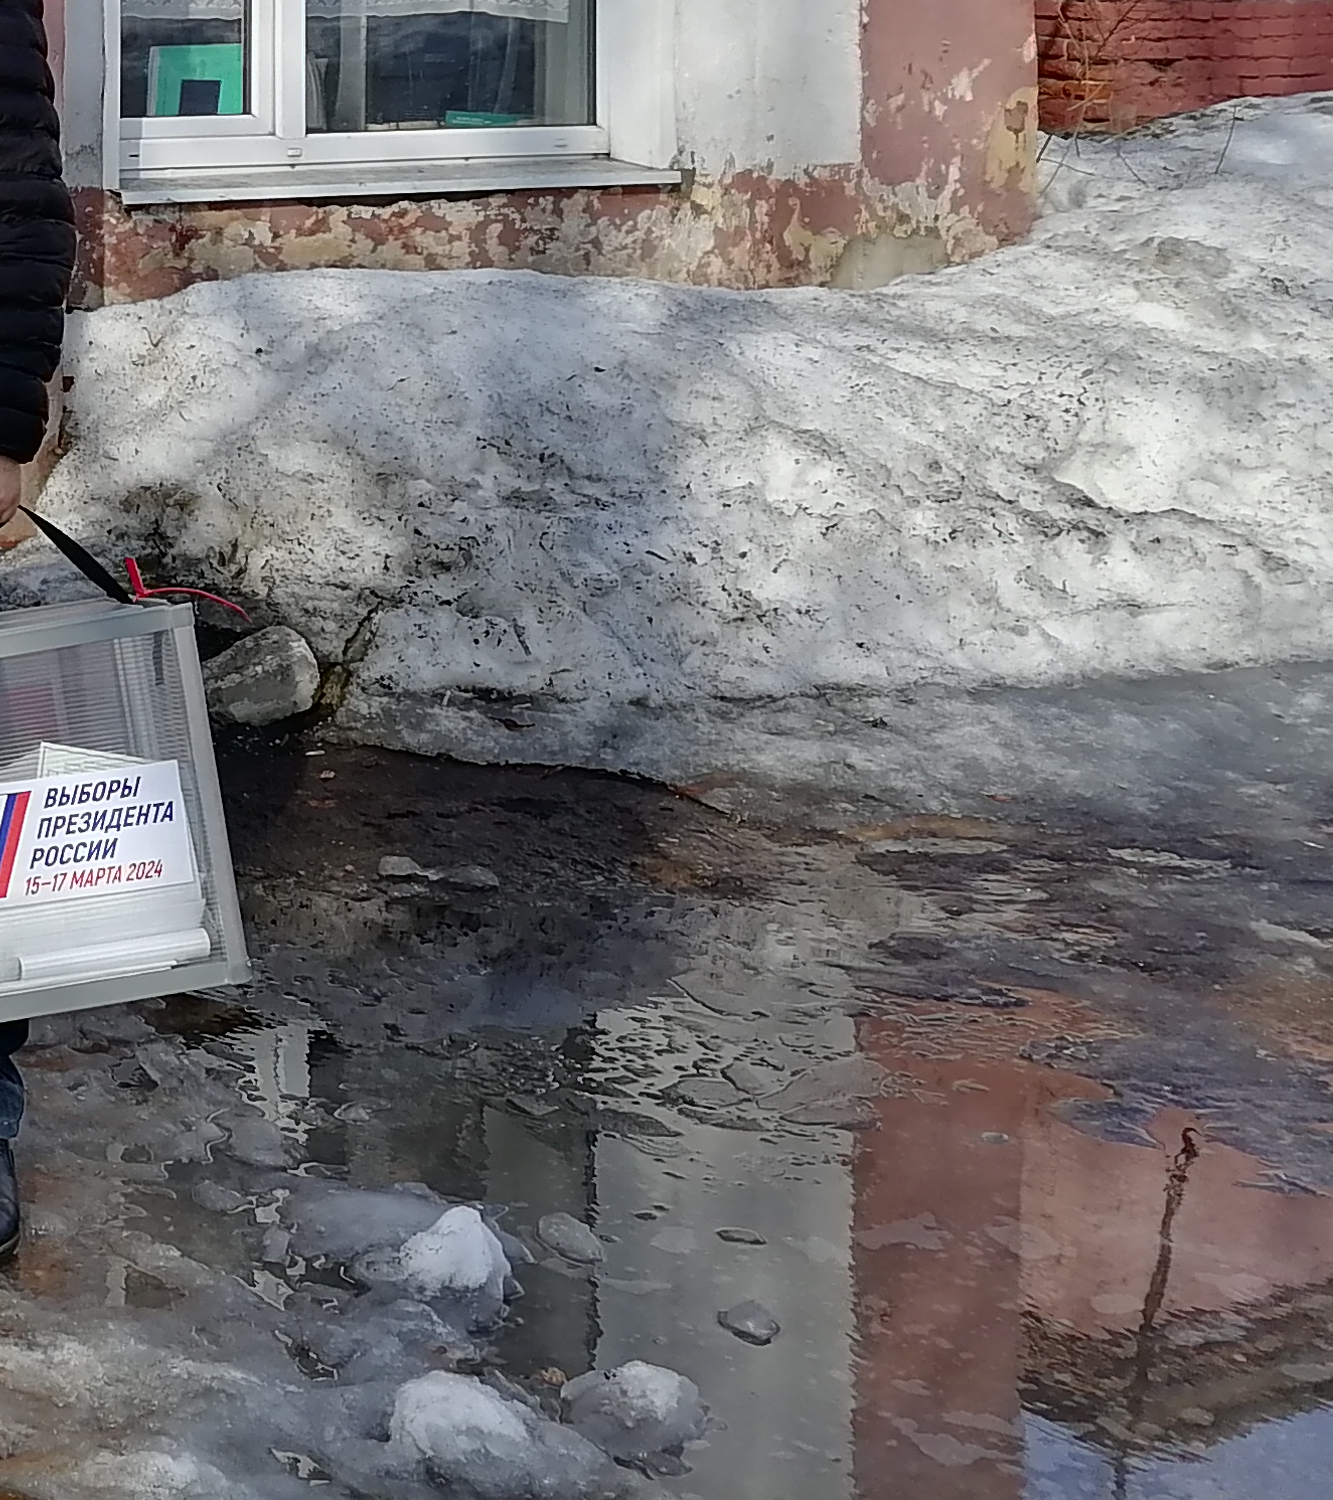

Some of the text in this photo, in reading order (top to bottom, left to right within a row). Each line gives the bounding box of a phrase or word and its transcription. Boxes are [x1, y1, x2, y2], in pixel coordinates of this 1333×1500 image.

[43, 776, 141, 809] ВЫБОРЫ
[37, 801, 175, 839] ПРЕЗИДЕНТА
[29, 837, 118, 870] РОССИИ
[69, 865, 122, 890] МАРТА
[126, 859, 163, 882] 2024
